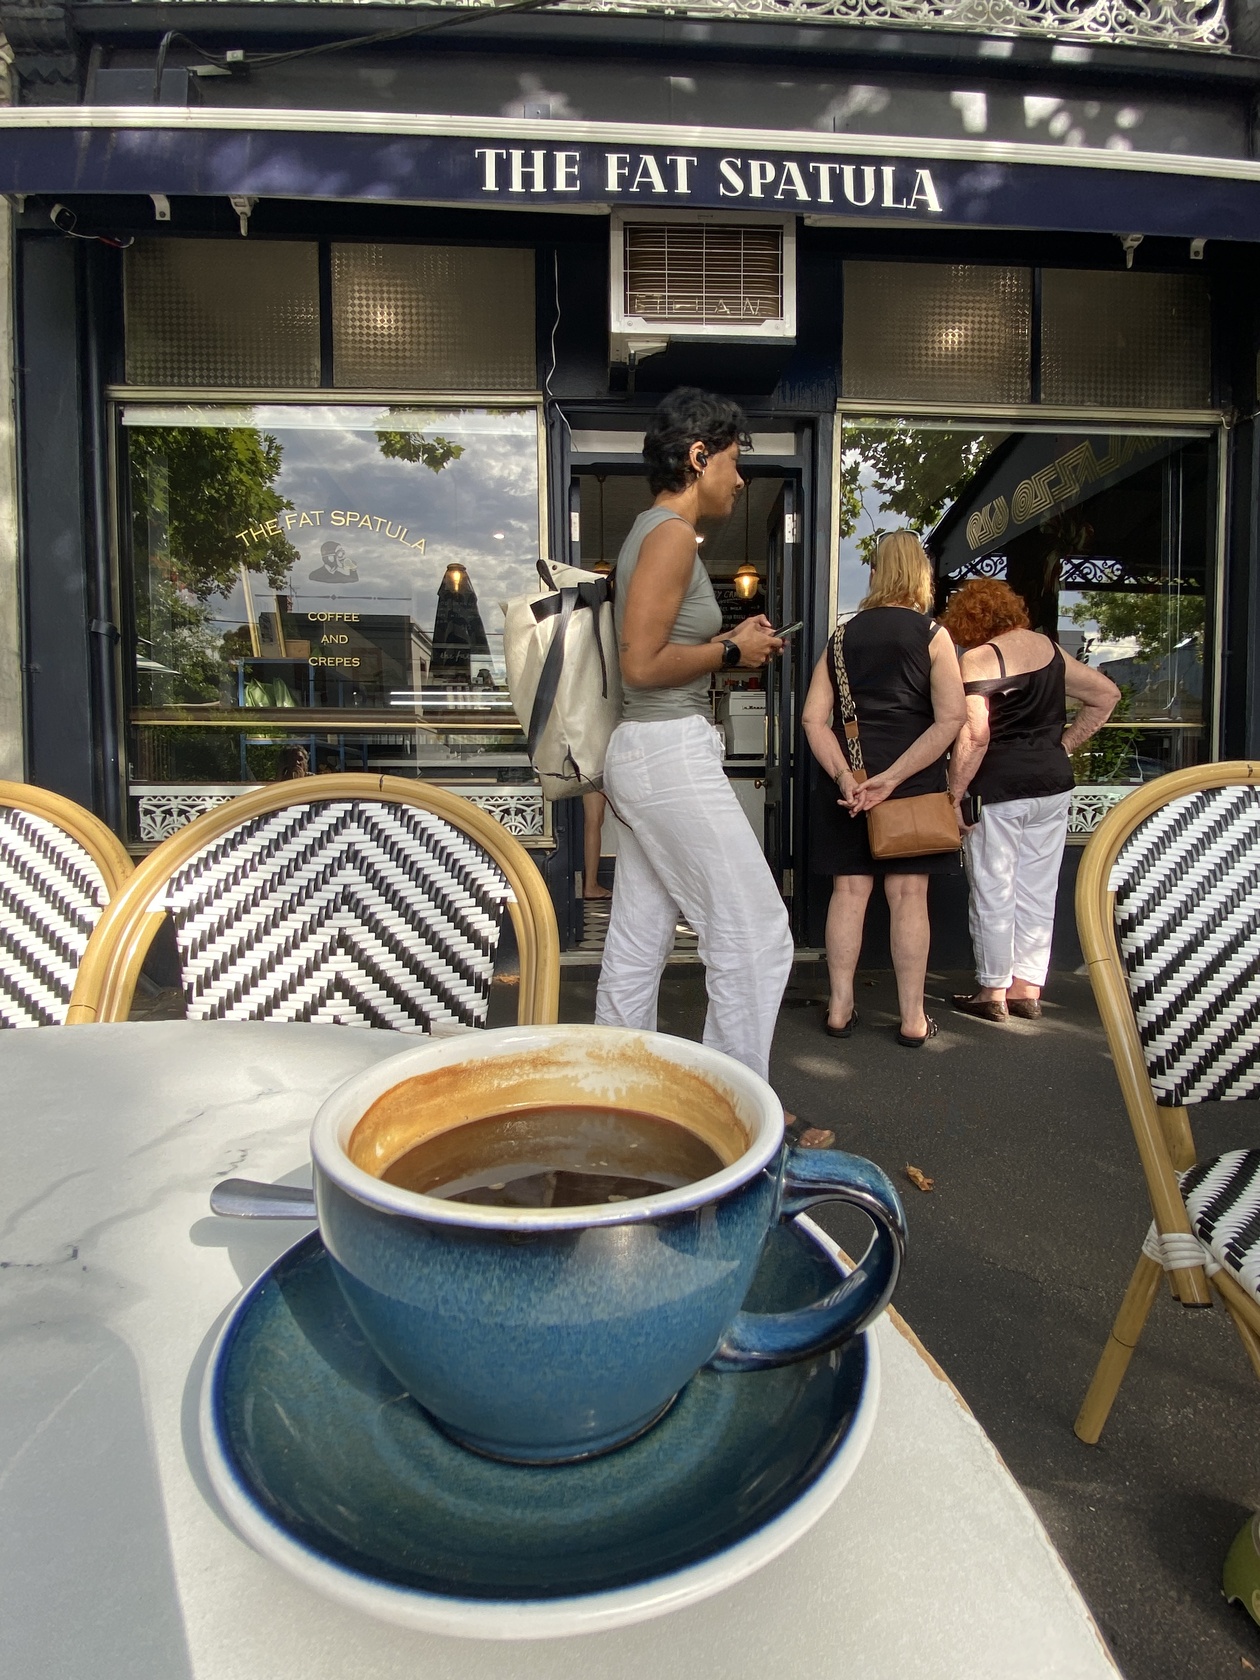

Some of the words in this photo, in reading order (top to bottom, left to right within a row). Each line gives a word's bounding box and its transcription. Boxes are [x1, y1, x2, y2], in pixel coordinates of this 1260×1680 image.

[475, 148, 581, 193] THE
[603, 153, 698, 194] FAT
[719, 157, 943, 212] SPATULA
[235, 518, 282, 547] THE
[284, 510, 325, 531] FAT
[330, 510, 427, 555] SPATULA
[307, 611, 360, 622] COFFEE
[320, 634, 349, 644] AND
[308, 656, 361, 667] CREPES
